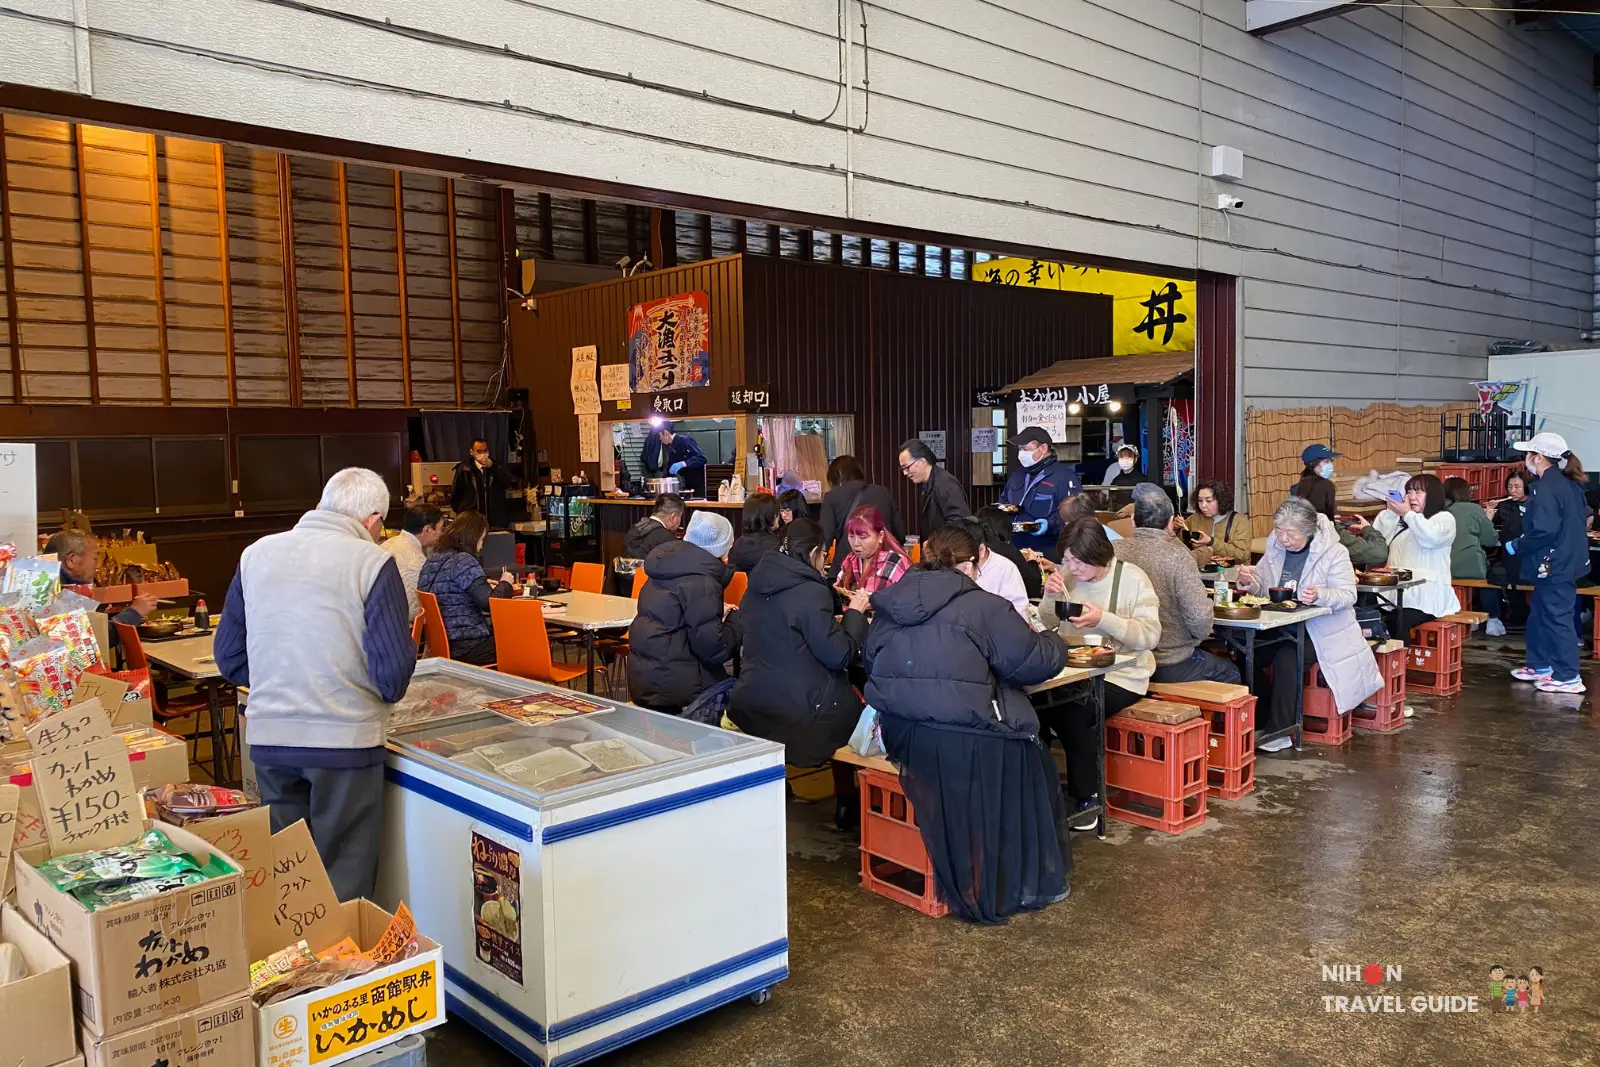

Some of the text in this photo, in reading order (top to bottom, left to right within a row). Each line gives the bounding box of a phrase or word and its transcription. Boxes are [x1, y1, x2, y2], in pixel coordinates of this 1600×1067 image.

[1133, 282, 1187, 345] 丼
[656, 311, 678, 389] 大漁まつり
[653, 396, 683, 412] 受取口
[731, 389, 765, 405] 返却口
[1020, 387, 1068, 403] おかわり
[1076, 384, 1113, 405] 小屋
[38, 716, 91, 749] 生チョコ
[46, 750, 100, 780] カット
[64, 765, 116, 798] わかめ
[61, 810, 129, 844] チャック付き
[105, 912, 140, 929] 賞味期限
[288, 903, 327, 937] 800
[138, 930, 183, 953] カット
[134, 940, 210, 979] わかめ
[127, 983, 157, 1000] 輸入者
[159, 959, 227, 990] 株式会社丸協
[312, 970, 432, 1022] いかのふる里 函館駅弁
[315, 996, 428, 1054] いかめし
[111, 1040, 147, 1059] 賞味期限
